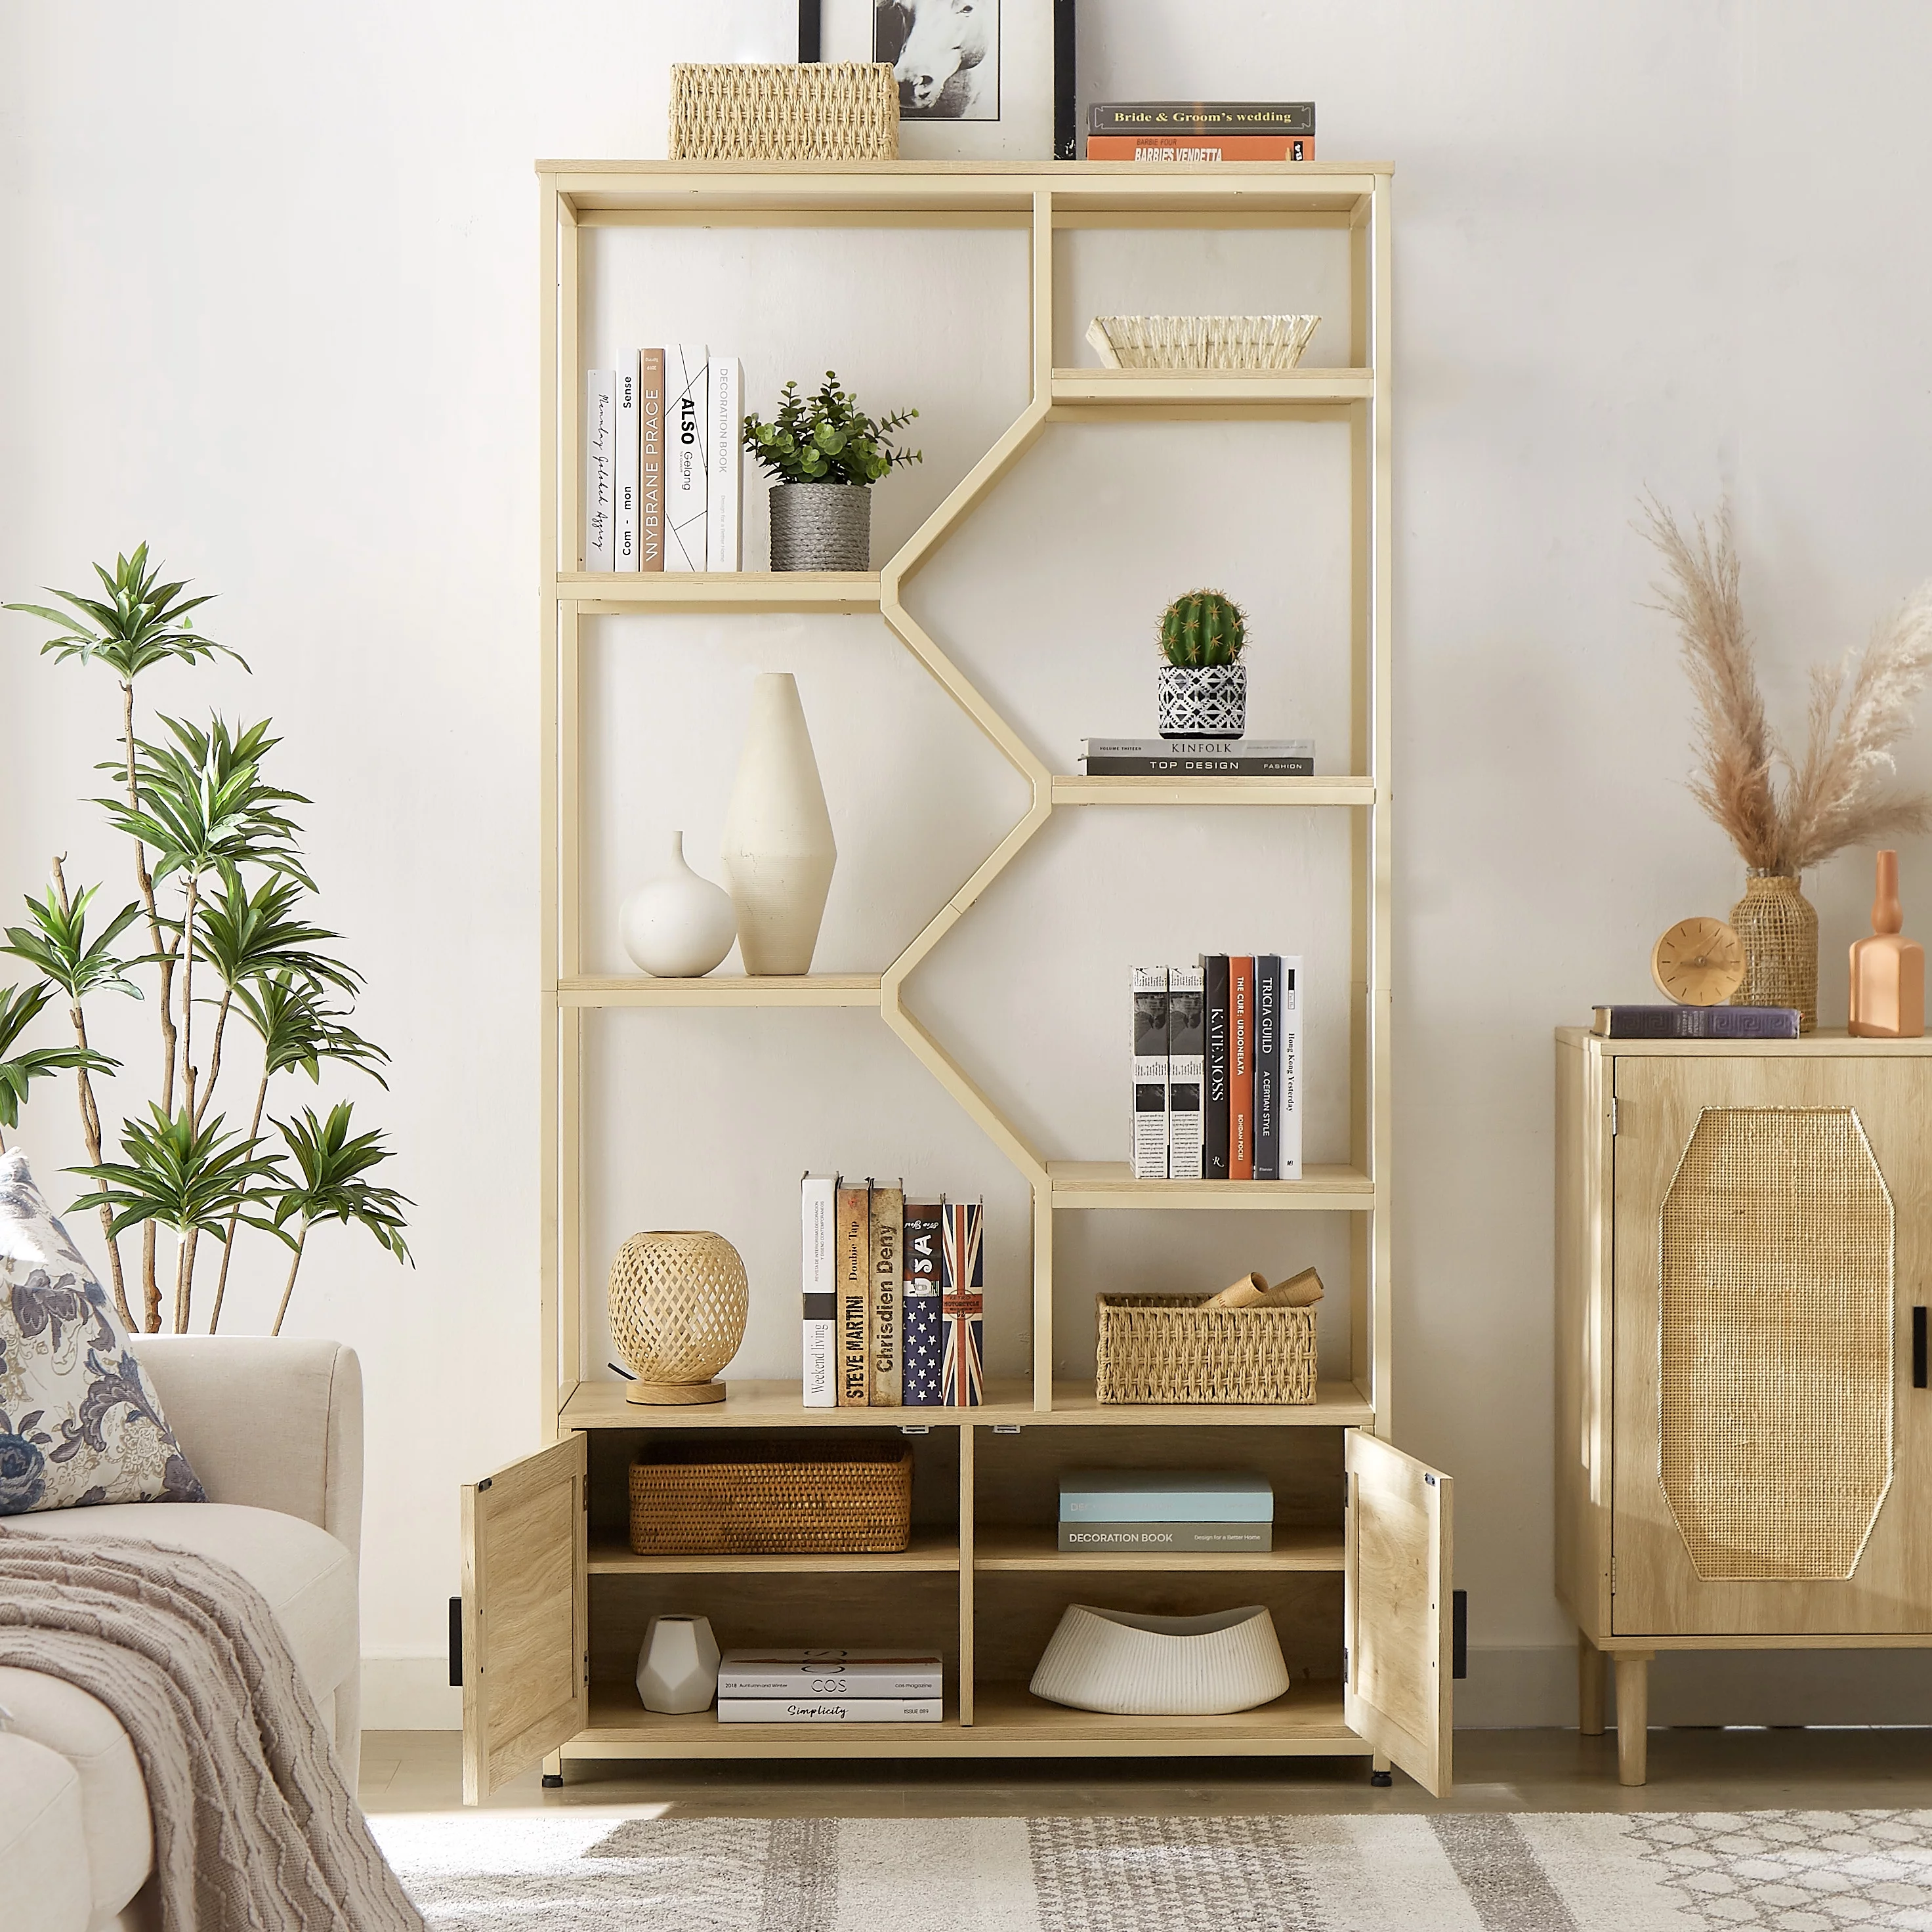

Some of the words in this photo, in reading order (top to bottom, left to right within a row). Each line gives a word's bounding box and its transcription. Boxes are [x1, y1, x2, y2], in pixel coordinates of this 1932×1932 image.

[1115, 112, 1152, 122] Bride
[1156, 112, 1168, 122] &
[1173, 112, 1232, 122] Groom's
[1237, 112, 1292, 123] wedding
[1176, 148, 1222, 161] VENDETTA
[623, 376, 631, 408] Sense
[646, 389, 658, 455] PRACE
[681, 398, 694, 444] ALSO
[681, 451, 693, 491] Gelang
[719, 441, 728, 473] BOOK
[646, 462, 658, 562] WYBRANE
[1149, 761, 1177, 769] TOP
[1185, 761, 1240, 770] DESIGN
[1171, 743, 1232, 753] KINFOLK
[1262, 977, 1272, 1016] TRICIA
[1262, 1018, 1272, 1054] GUILD
[848, 1221, 860, 1240] Tap
[876, 1224, 898, 1274] Deny
[914, 1233, 933, 1296] USA
[811, 1324, 828, 1349] living
[845, 1295, 864, 1353] MARTINI
[876, 1281, 893, 1374] Chrisdien
[811, 1353, 825, 1395] Weekend
[846, 1354, 864, 1400] STEVE
[1069, 1533, 1139, 1542] DECORATION
[1141, 1533, 1173, 1542] BOOK
[811, 1679, 847, 1692] COS
[788, 1705, 849, 1719] Simplicity
